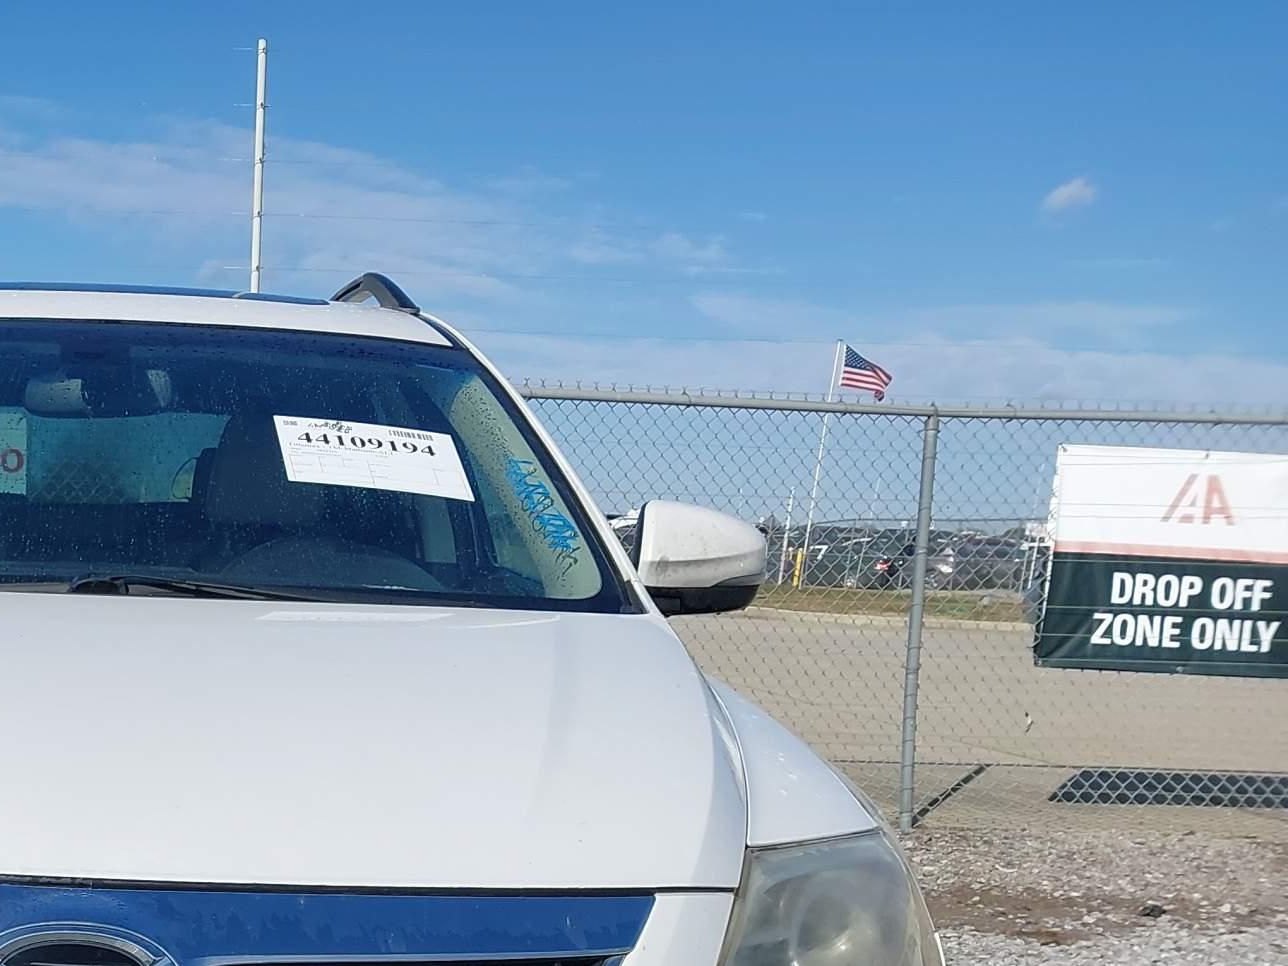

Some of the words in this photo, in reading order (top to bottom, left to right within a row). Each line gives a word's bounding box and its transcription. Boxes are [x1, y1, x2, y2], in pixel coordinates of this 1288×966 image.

[297, 432, 436, 457] 44109194
[1110, 571, 1203, 608] DROP
[1210, 577, 1274, 611] OFF
[1090, 613, 1183, 648] ZONE
[1191, 617, 1282, 653] ONLY
